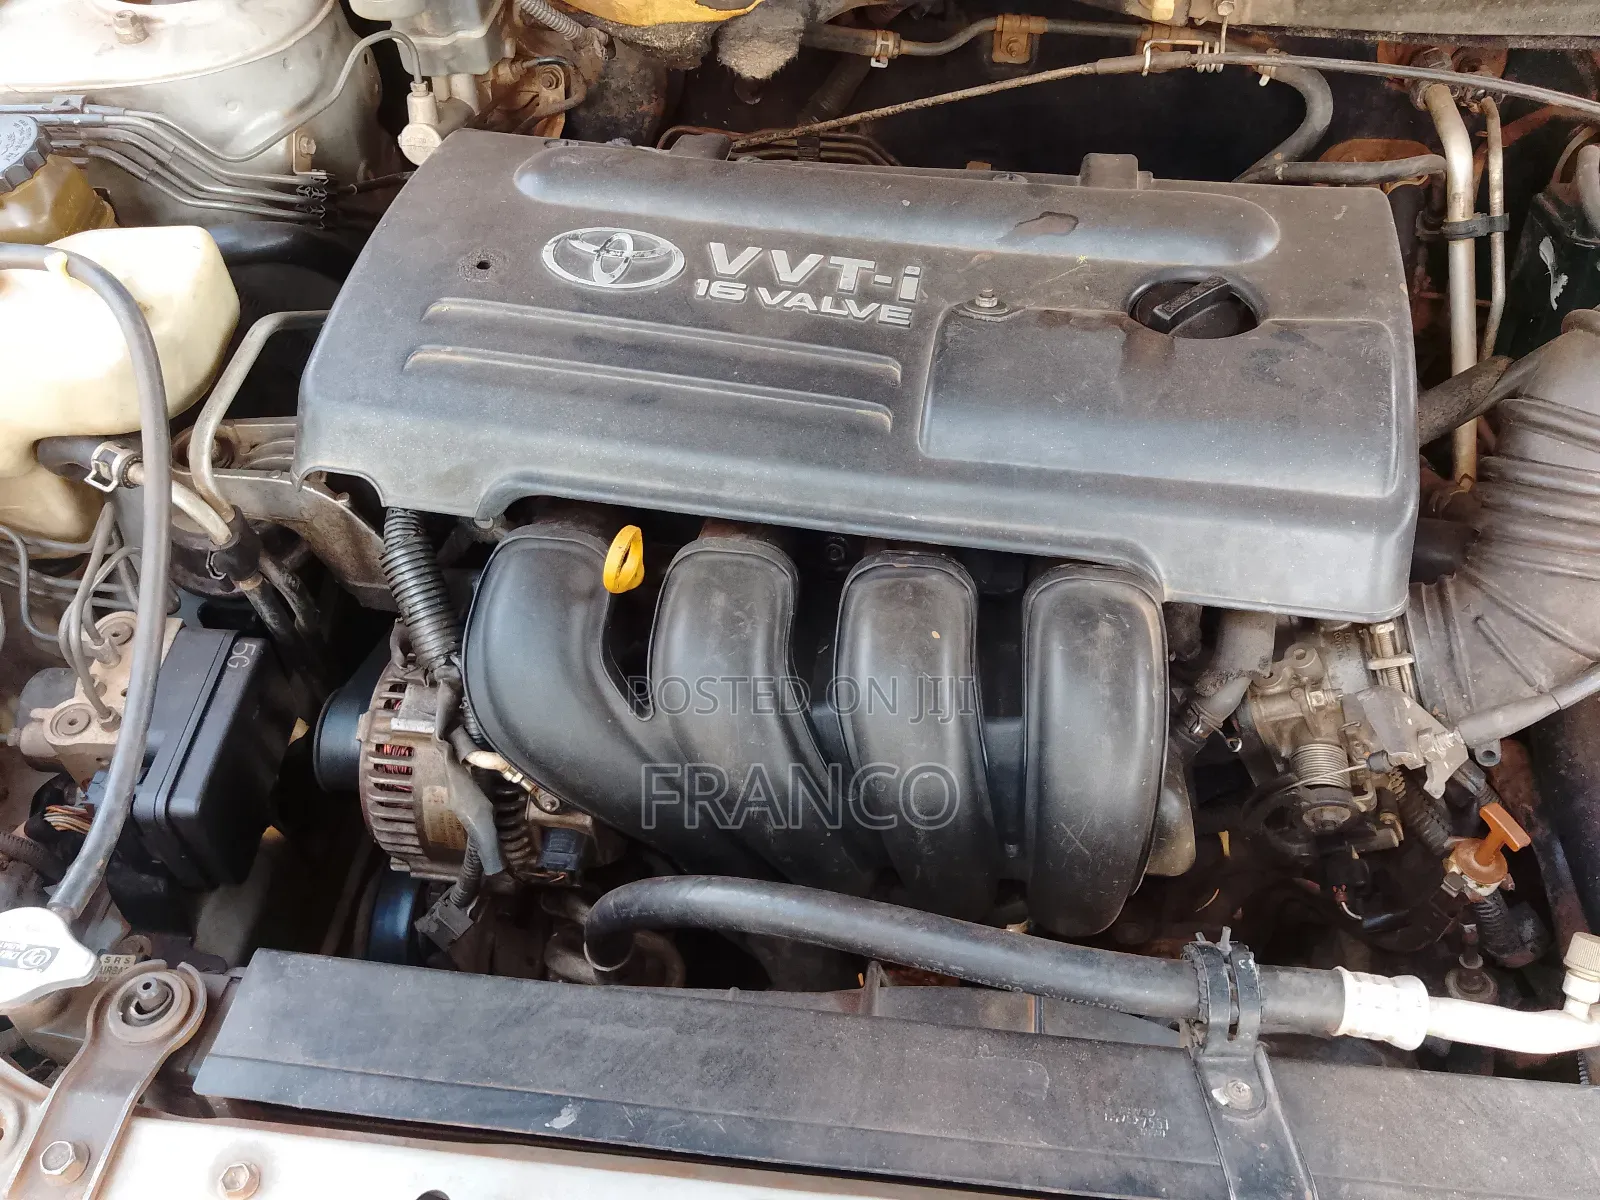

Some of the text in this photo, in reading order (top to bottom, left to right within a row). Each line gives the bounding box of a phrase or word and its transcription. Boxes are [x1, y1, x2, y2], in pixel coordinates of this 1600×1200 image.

[708, 242, 921, 302] VVT-i
[695, 278, 912, 327] 16 VALVE
[227, 642, 257, 668] 5G
